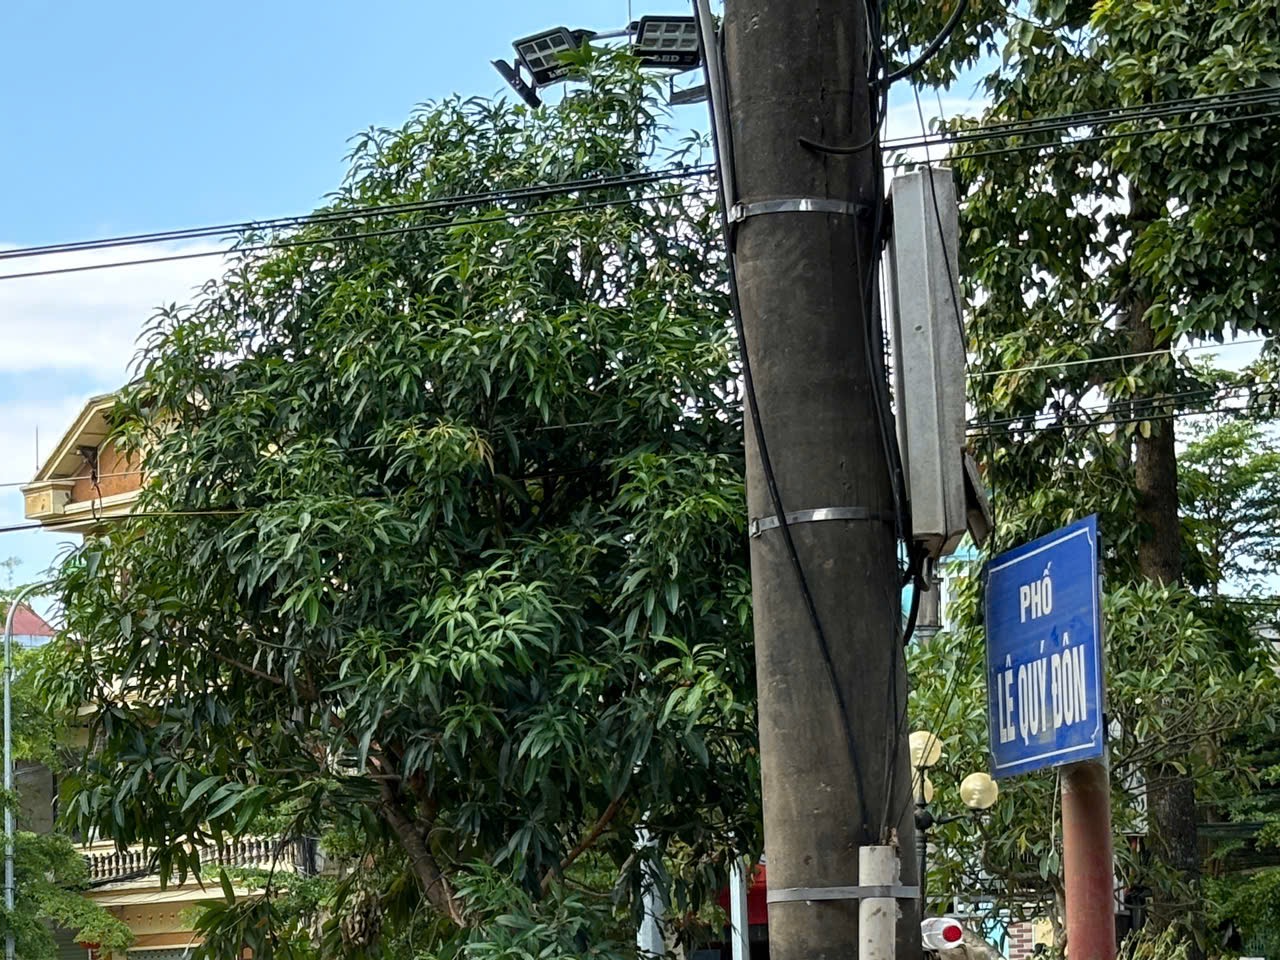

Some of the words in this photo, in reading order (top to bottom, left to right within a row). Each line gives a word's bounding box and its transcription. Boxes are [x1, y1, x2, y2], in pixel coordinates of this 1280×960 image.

[1019, 561, 1054, 624] PHỐ
[997, 653, 1015, 744] LÊ
[1018, 639, 1048, 746] QUÝ
[1051, 631, 1087, 730] ĐÔN
